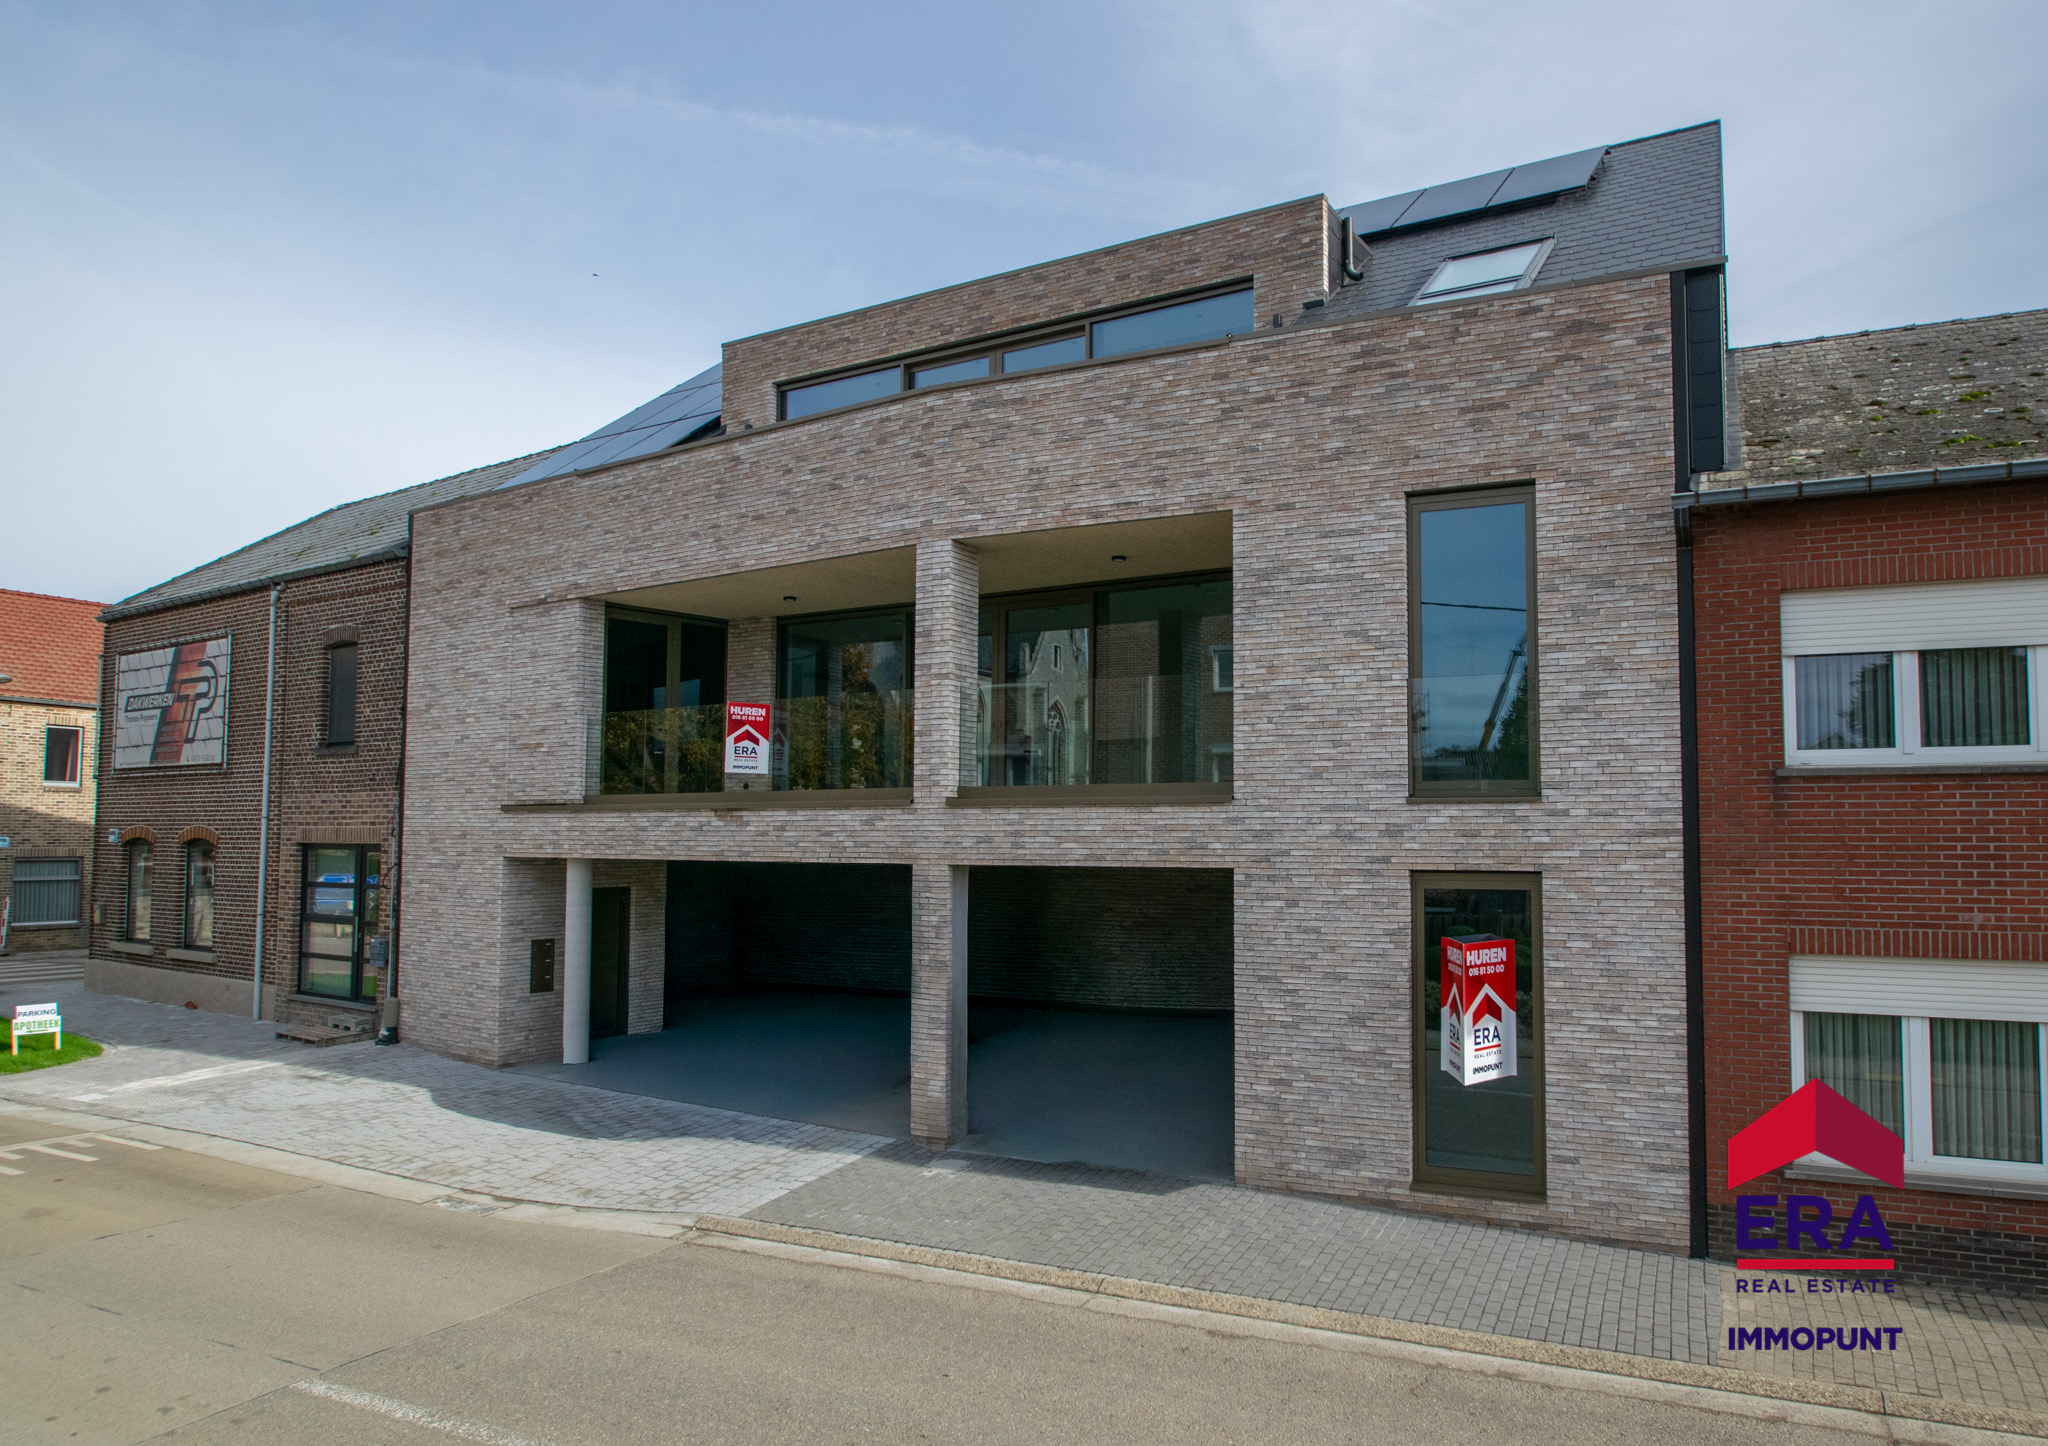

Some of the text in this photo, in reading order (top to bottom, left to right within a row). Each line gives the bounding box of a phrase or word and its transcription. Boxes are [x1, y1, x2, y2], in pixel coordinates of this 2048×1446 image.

[127, 693, 175, 710] DAKWERKEN
[730, 706, 766, 716] HUREN
[734, 746, 758, 755] ERA
[1466, 947, 1507, 966] HUREN
[1468, 968, 1479, 976] 016
[1480, 966, 1486, 975] 81
[1486, 965, 1495, 974] 50
[1495, 964, 1505, 973] 00
[17, 1009, 57, 1017] PARKING
[14, 1020, 60, 1031] APOTHEEK
[1450, 1023, 1460, 1045] ERA
[1474, 1025, 1501, 1045] ERA
[1486, 1049, 1502, 1057] ESTATE
[1473, 1062, 1503, 1074] IMMOPUNT
